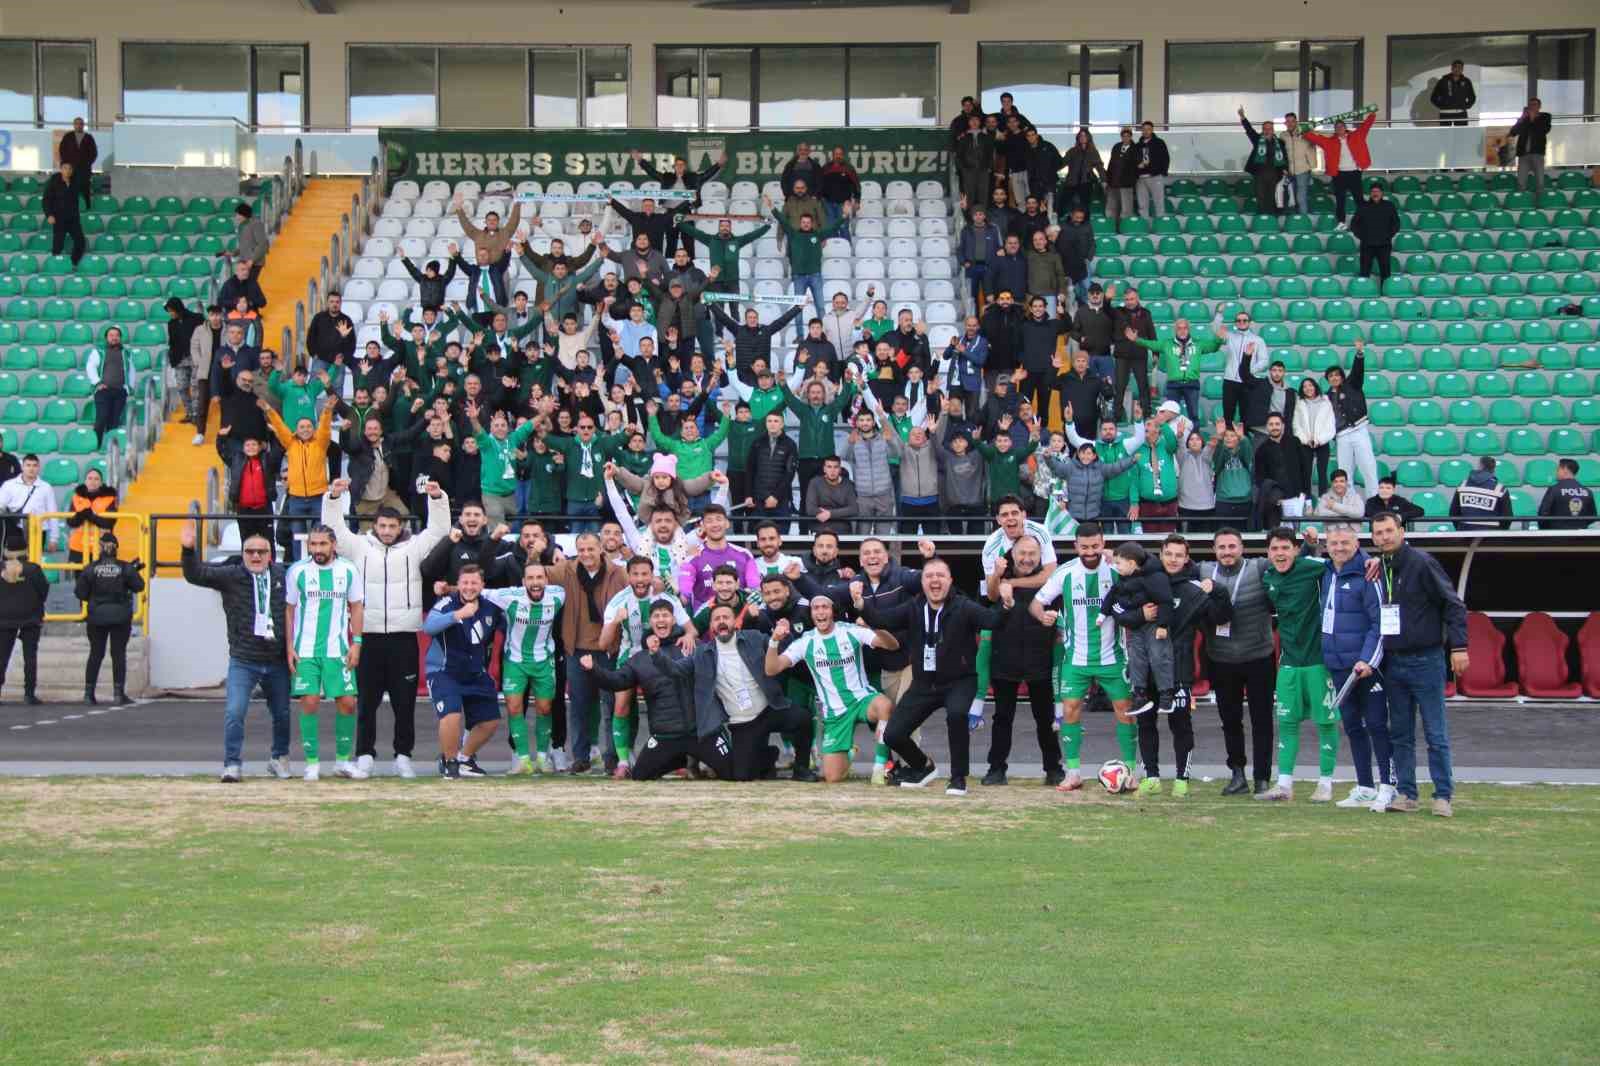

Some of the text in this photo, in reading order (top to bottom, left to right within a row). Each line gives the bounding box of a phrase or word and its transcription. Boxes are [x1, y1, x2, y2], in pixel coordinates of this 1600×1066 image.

[416, 152, 552, 176] HERKES
[816, 656, 855, 668] mikroman
[1175, 698, 1186, 708] 10
